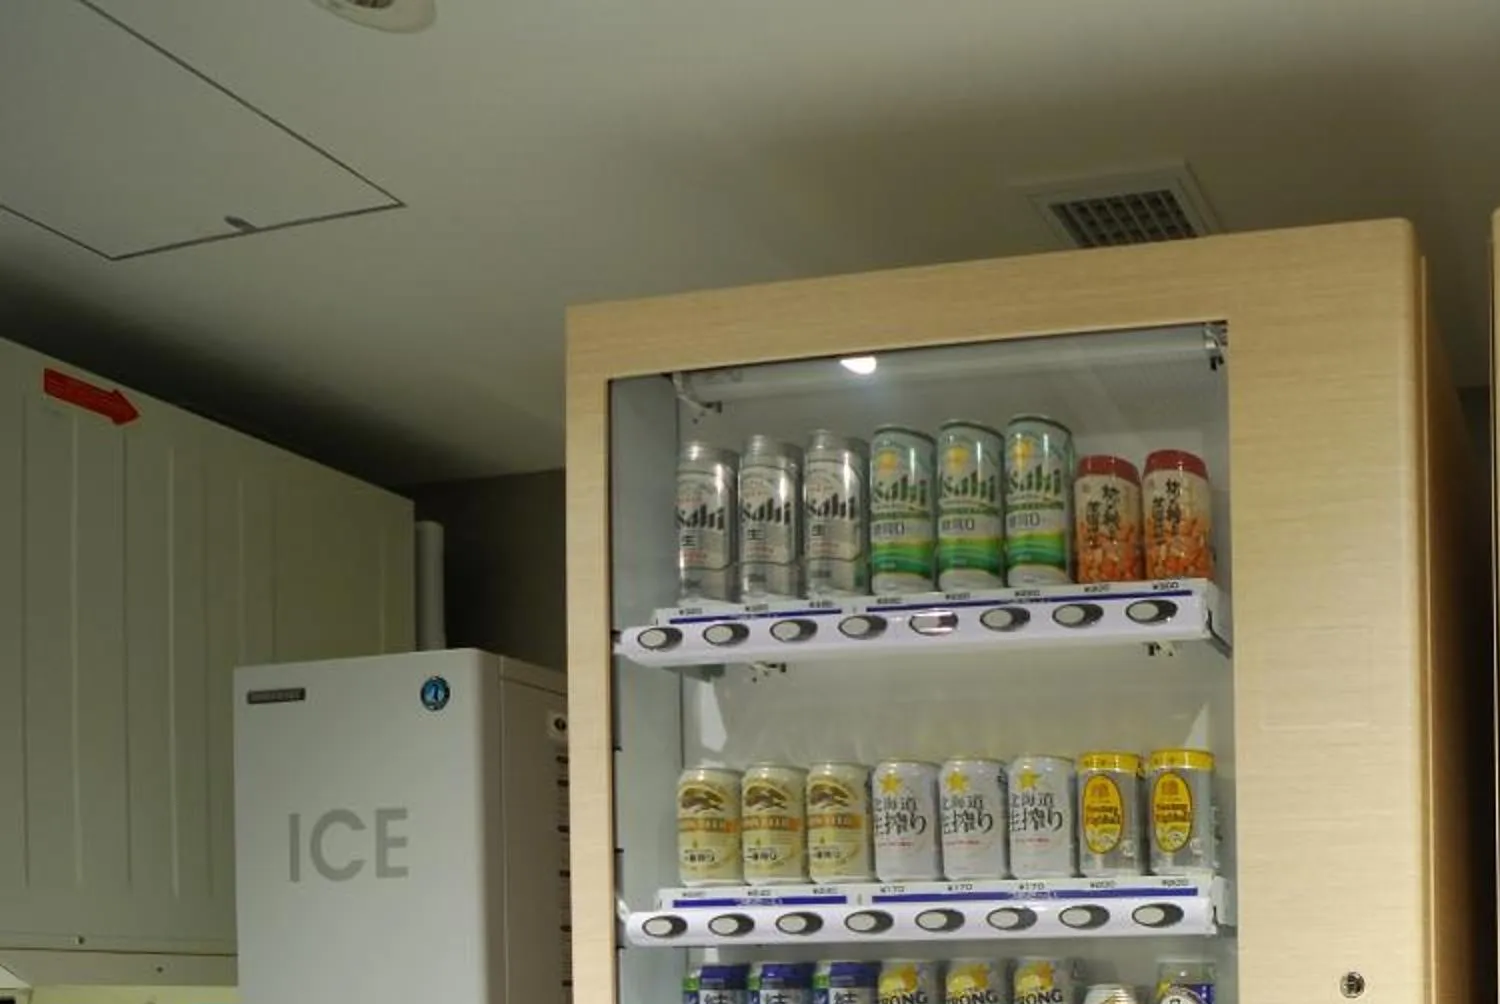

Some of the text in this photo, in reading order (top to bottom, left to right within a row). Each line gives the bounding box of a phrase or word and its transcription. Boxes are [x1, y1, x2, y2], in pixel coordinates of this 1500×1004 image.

[874, 474, 926, 506] sahi
[942, 470, 996, 502] sahi
[1009, 464, 1062, 497] sahi
[678, 504, 724, 531] sahi
[742, 497, 790, 524] sahi
[809, 492, 855, 520] sahi
[288, 807, 410, 883] ICE
